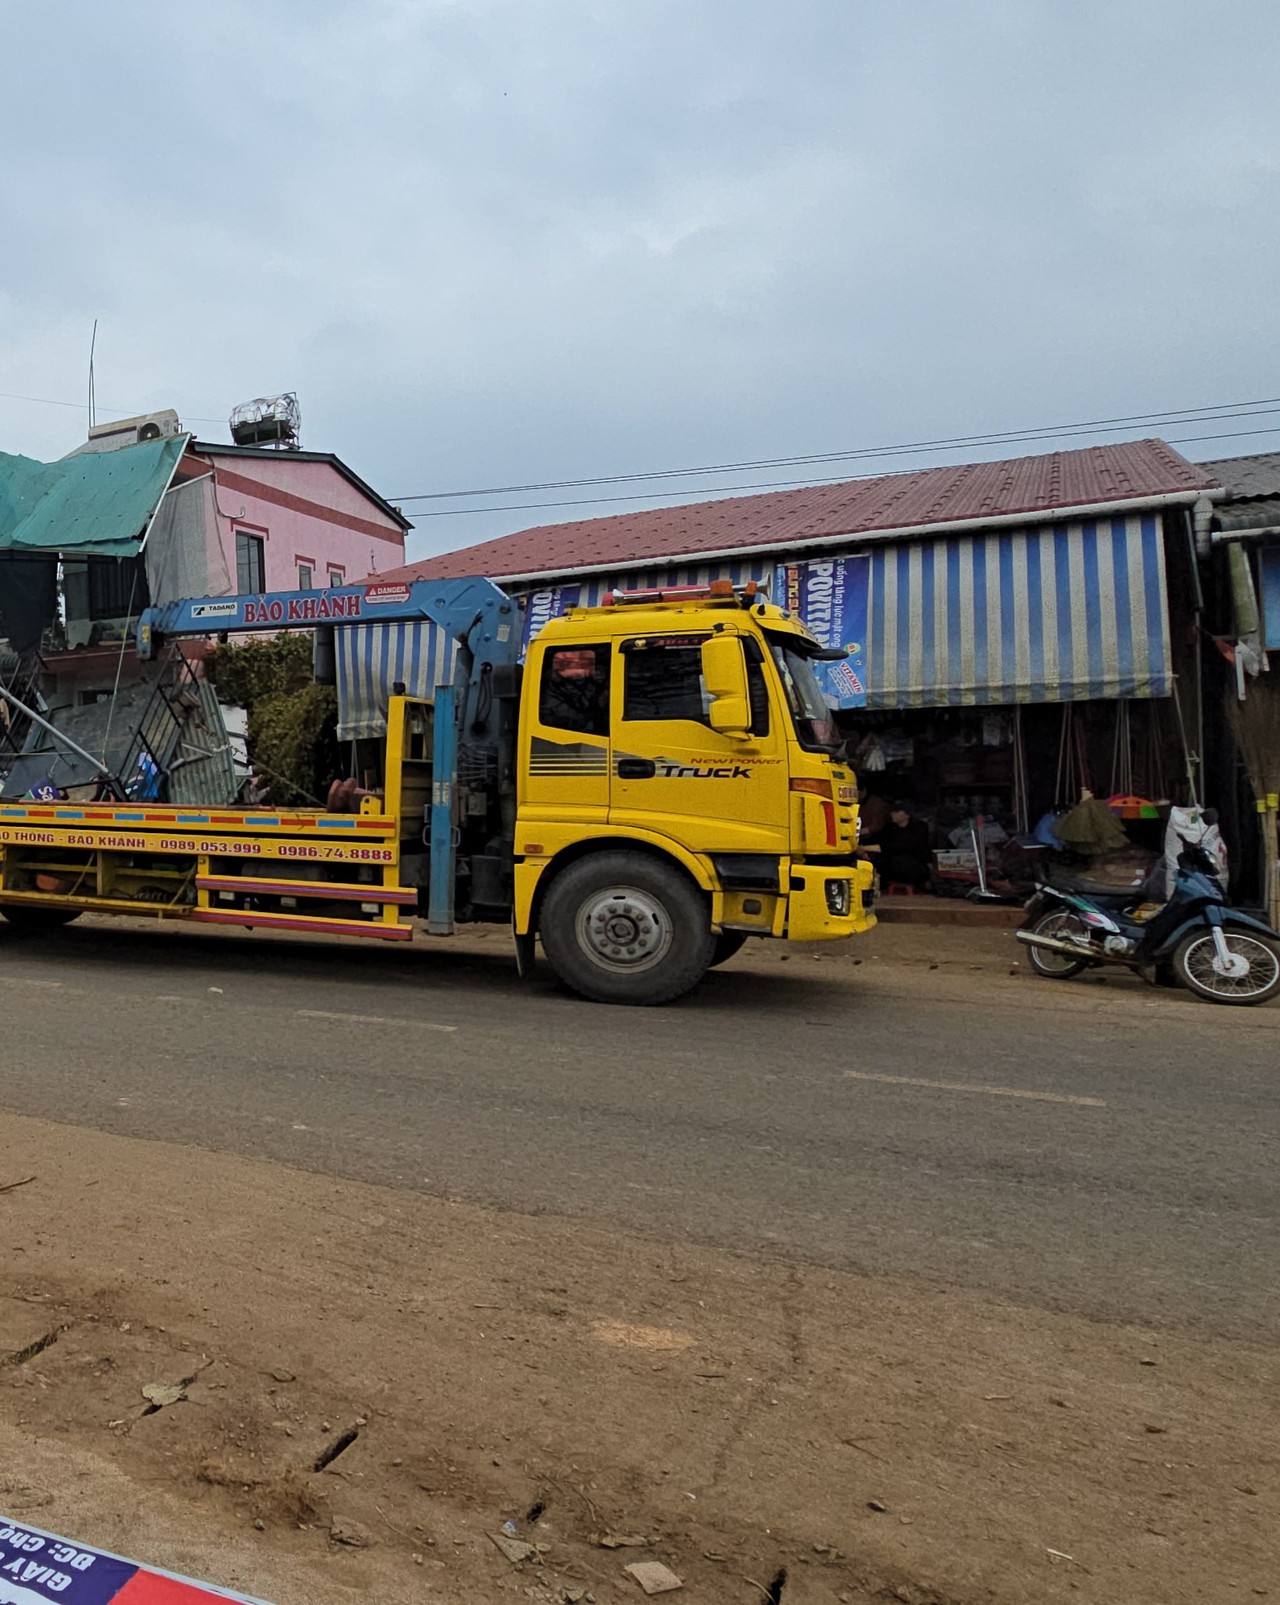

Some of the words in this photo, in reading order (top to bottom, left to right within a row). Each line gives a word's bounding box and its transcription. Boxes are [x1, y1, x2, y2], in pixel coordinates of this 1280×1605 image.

[377, 586, 406, 595] DANGER
[208, 603, 236, 611] TADANO
[243, 593, 283, 623] BẢO
[287, 590, 361, 621] KHÁNH
[839, 662, 864, 694] VITAMIN
[659, 766, 752, 779] Truck
[98, 833, 146, 848] KHÁNH
[160, 839, 262, 854] 0989.053.999
[278, 845, 393, 861] 0986.74.8888
[48, 1544, 97, 1572] ĐC:
[3, 1557, 73, 1592] GIẤY
